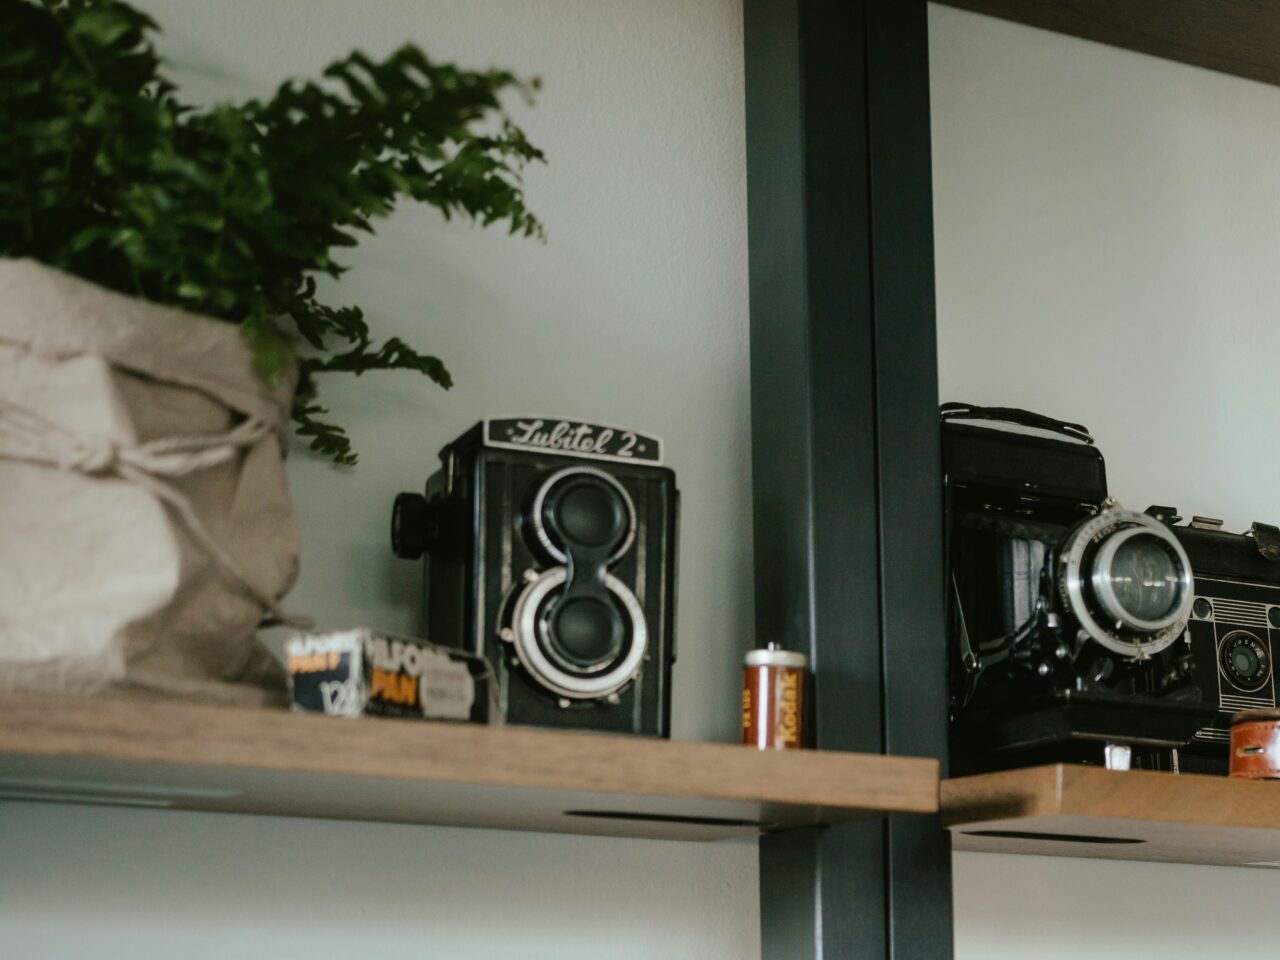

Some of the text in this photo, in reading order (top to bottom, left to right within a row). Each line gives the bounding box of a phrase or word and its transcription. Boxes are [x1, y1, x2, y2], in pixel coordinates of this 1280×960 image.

[511, 420, 638, 457] Lubitel 2
[780, 672, 797, 742] Kodak
